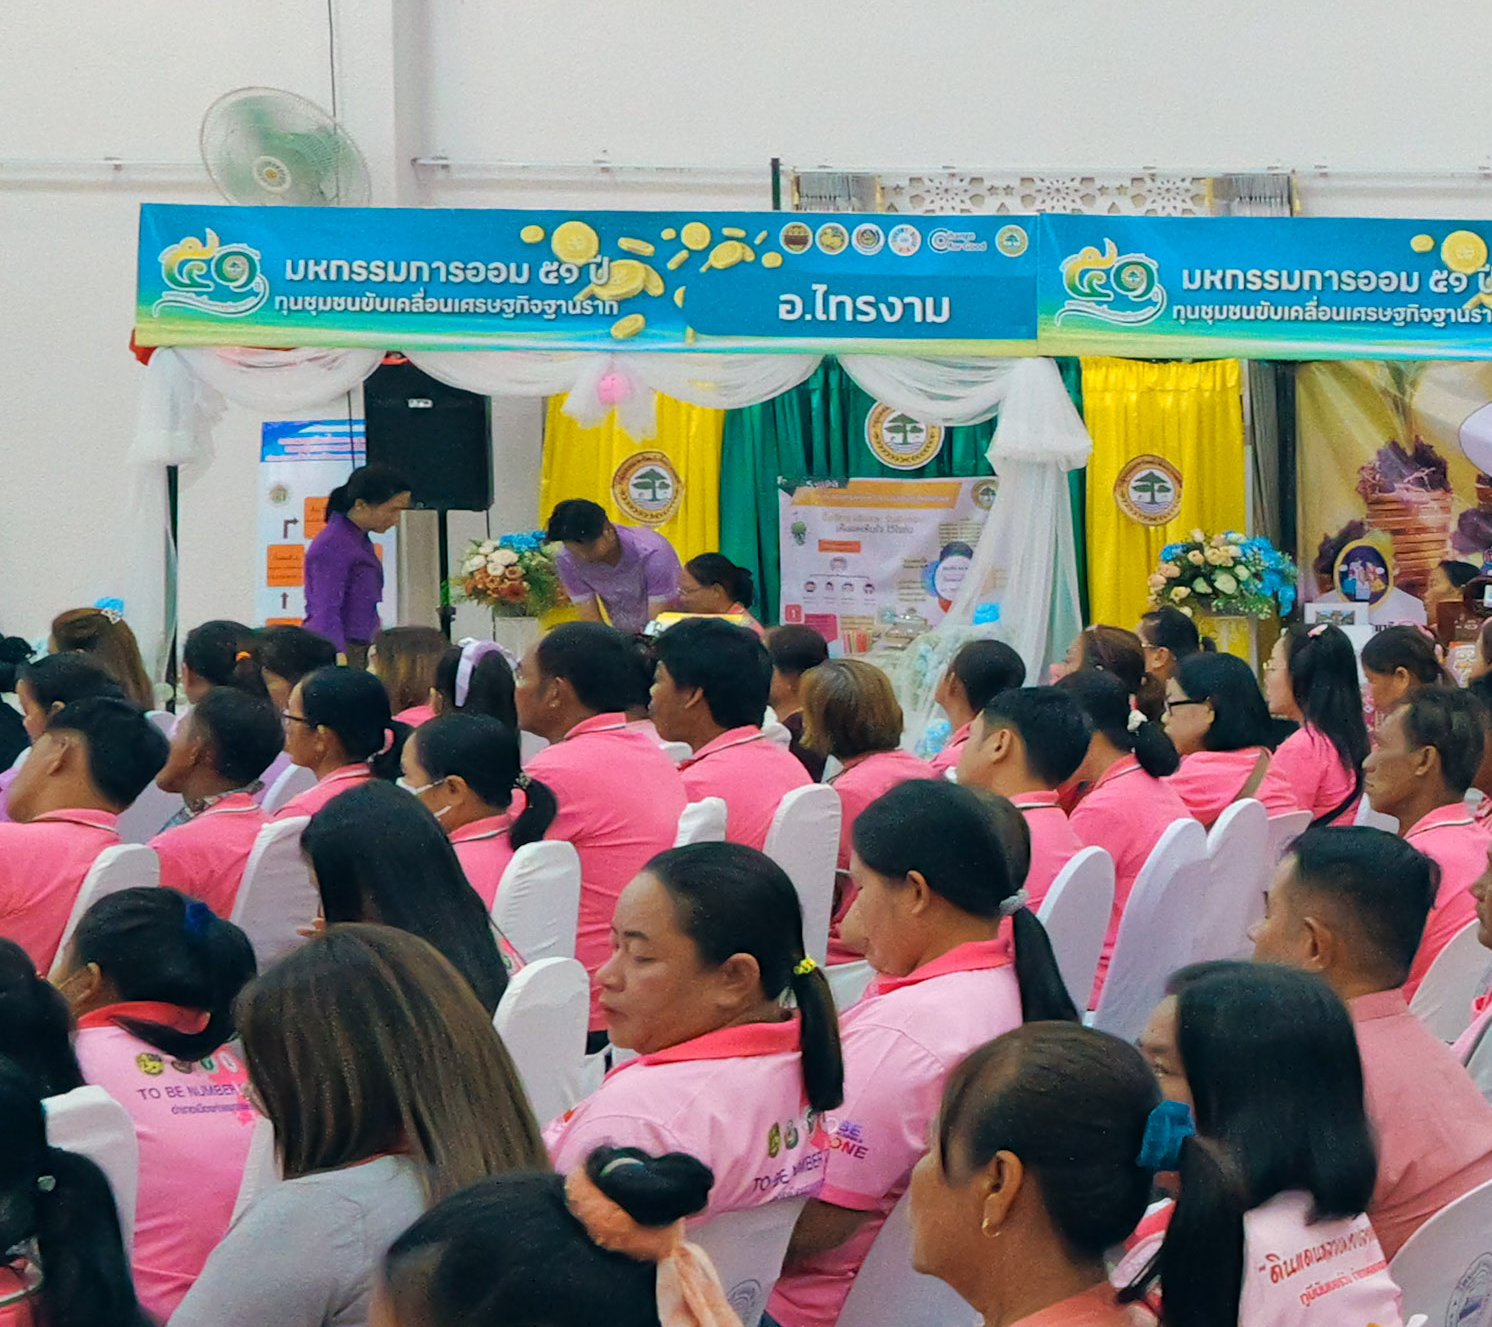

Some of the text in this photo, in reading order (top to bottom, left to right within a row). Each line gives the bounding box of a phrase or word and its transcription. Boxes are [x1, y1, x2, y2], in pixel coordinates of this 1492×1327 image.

[285, 254, 612, 285] มหกรรมการออม ๕๑ ปี
[1181, 266, 1420, 293] มหกรรมการออม
[1429, 269, 1468, 294] ๕๑
[777, 283, 951, 323] อ.ไทรงาม
[137, 1087, 161, 1101] TO
[165, 1085, 185, 1098] BE
[829, 1137, 869, 1159] ONE
